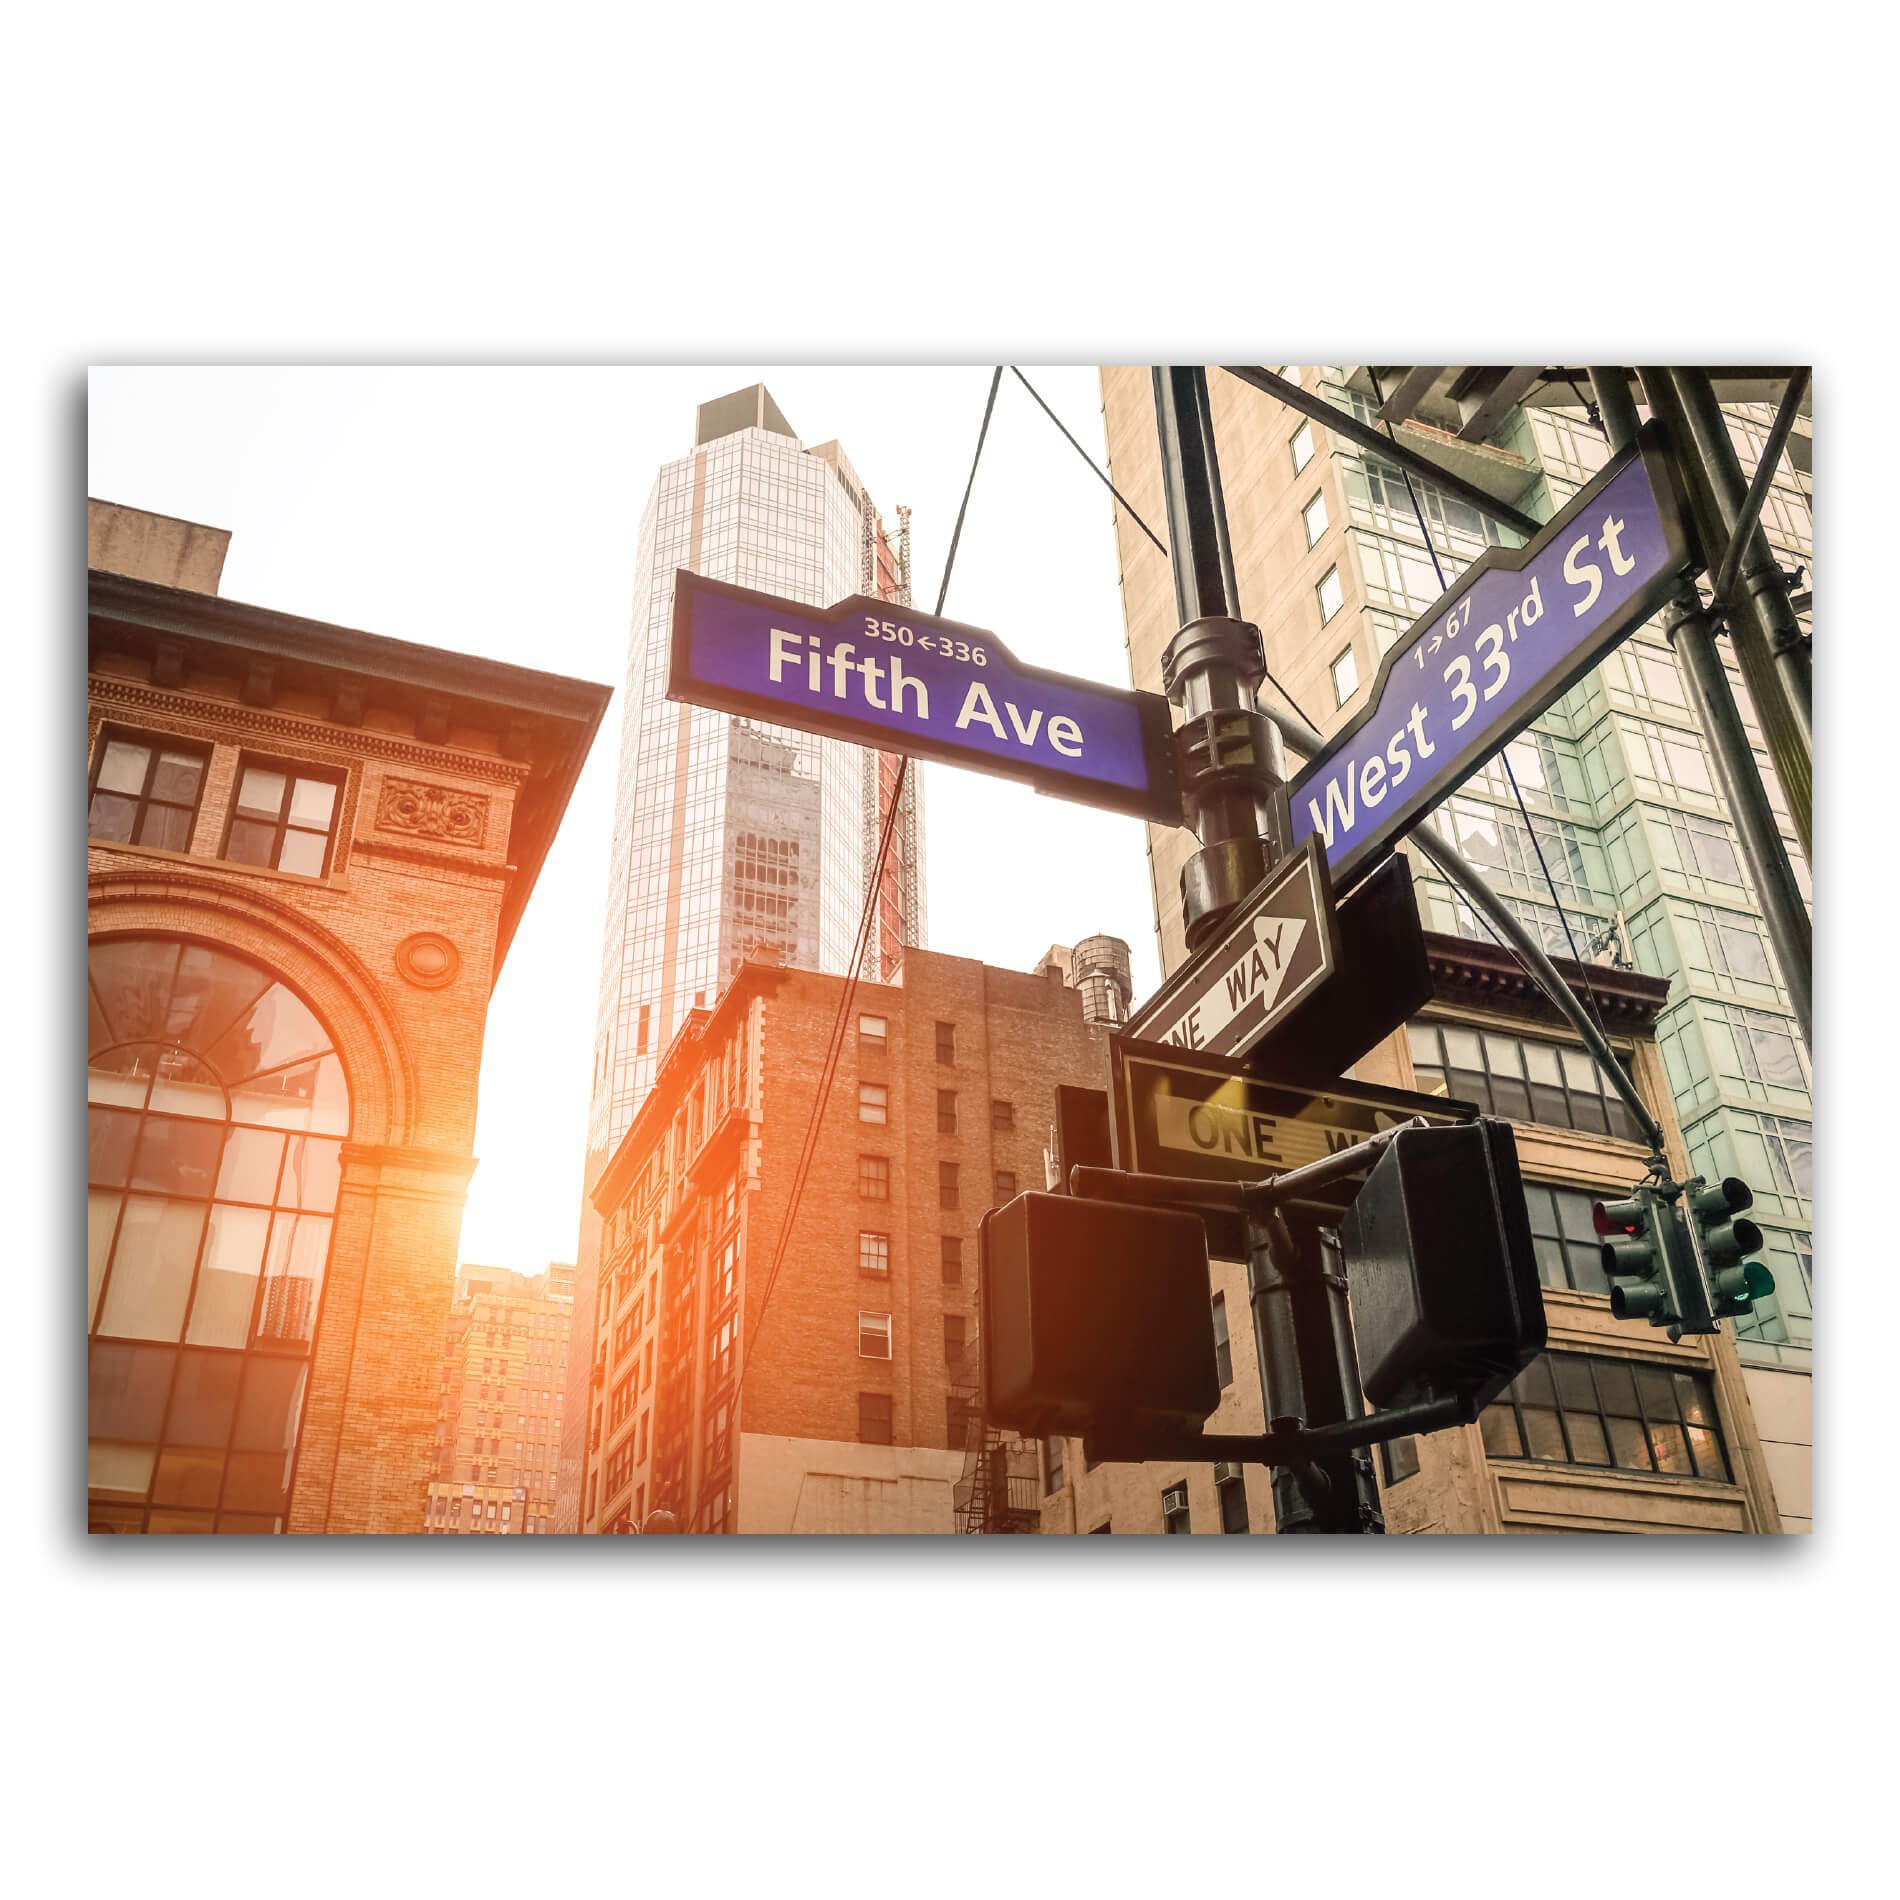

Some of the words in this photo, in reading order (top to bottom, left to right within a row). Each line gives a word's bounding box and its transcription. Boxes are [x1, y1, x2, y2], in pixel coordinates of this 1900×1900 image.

[864, 617, 914, 648] 350
[939, 636, 988, 667] 336
[1446, 597, 1471, 640] 67
[769, 627, 929, 720] Fifth
[955, 681, 1084, 758] Ave
[1308, 700, 1436, 850] West
[1443, 576, 1545, 732] 33rd
[1562, 513, 1637, 618] St
[1162, 1006, 1205, 1050] NE
[1226, 922, 1283, 1011] WAY
[1188, 1105, 1282, 1163] ONE
